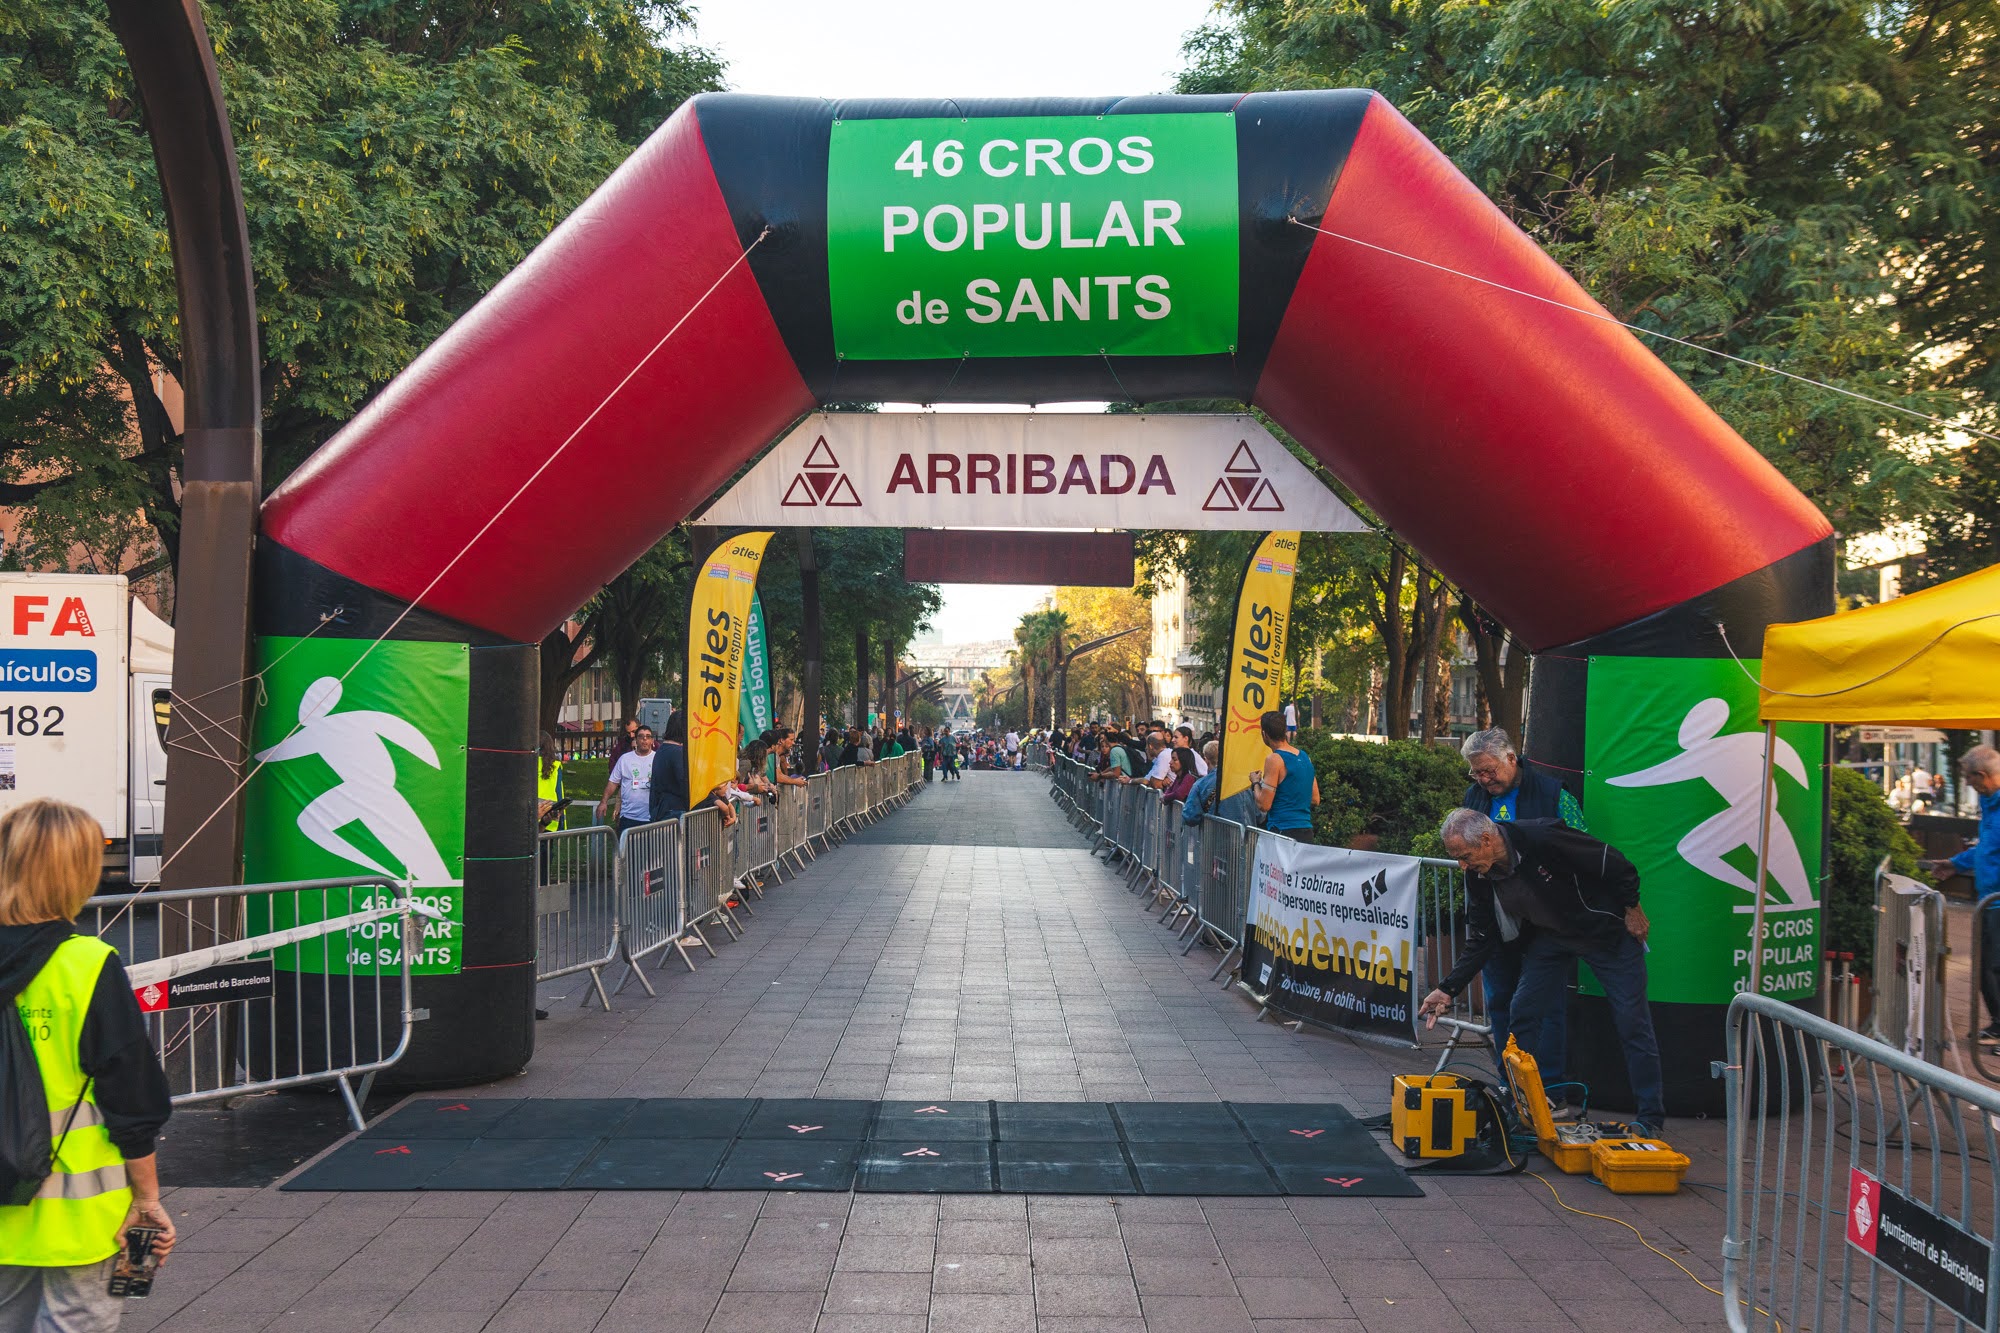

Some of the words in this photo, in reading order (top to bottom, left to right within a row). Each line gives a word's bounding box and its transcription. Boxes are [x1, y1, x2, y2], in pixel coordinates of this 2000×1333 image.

[894, 139, 964, 178] 46
[979, 136, 1155, 177] CROS
[883, 199, 1185, 253] POPULAR
[896, 290, 950, 325] de
[965, 274, 1172, 323] SANTS
[885, 452, 1177, 496] ARRIBADA
[732, 544, 760, 562] atles
[1274, 538, 1298, 551] atles
[13, 595, 96, 637] FA
[729, 616, 743, 669] l'esport!
[1241, 603, 1272, 709] atles
[700, 607, 730, 713] atles
[728, 672, 737, 691] viu
[1270, 669, 1279, 687] viu
[1295, 869, 1299, 888] i
[1301, 874, 1345, 897] sobirana
[360, 895, 388, 911] 46
[1284, 893, 1327, 916] persones
[1330, 905, 1409, 930] represaliades
[1773, 917, 1813, 939] CROS
[346, 947, 372, 965] de
[1733, 944, 1813, 967] PPULAR
[171, 980, 218, 996] Ajuntament
[219, 978, 230, 989] de
[231, 975, 271, 987] Barcelona
[1762, 970, 1813, 993] SANTS
[1323, 988, 1334, 1003] ni
[1334, 992, 1356, 1011] oblit
[1356, 997, 1366, 1013] ni
[1370, 1000, 1406, 1023] perdó
[1879, 1213, 1926, 1257] Ajuntament
[1927, 1243, 1939, 1263] de
[1940, 1249, 1985, 1294] Barcelona
